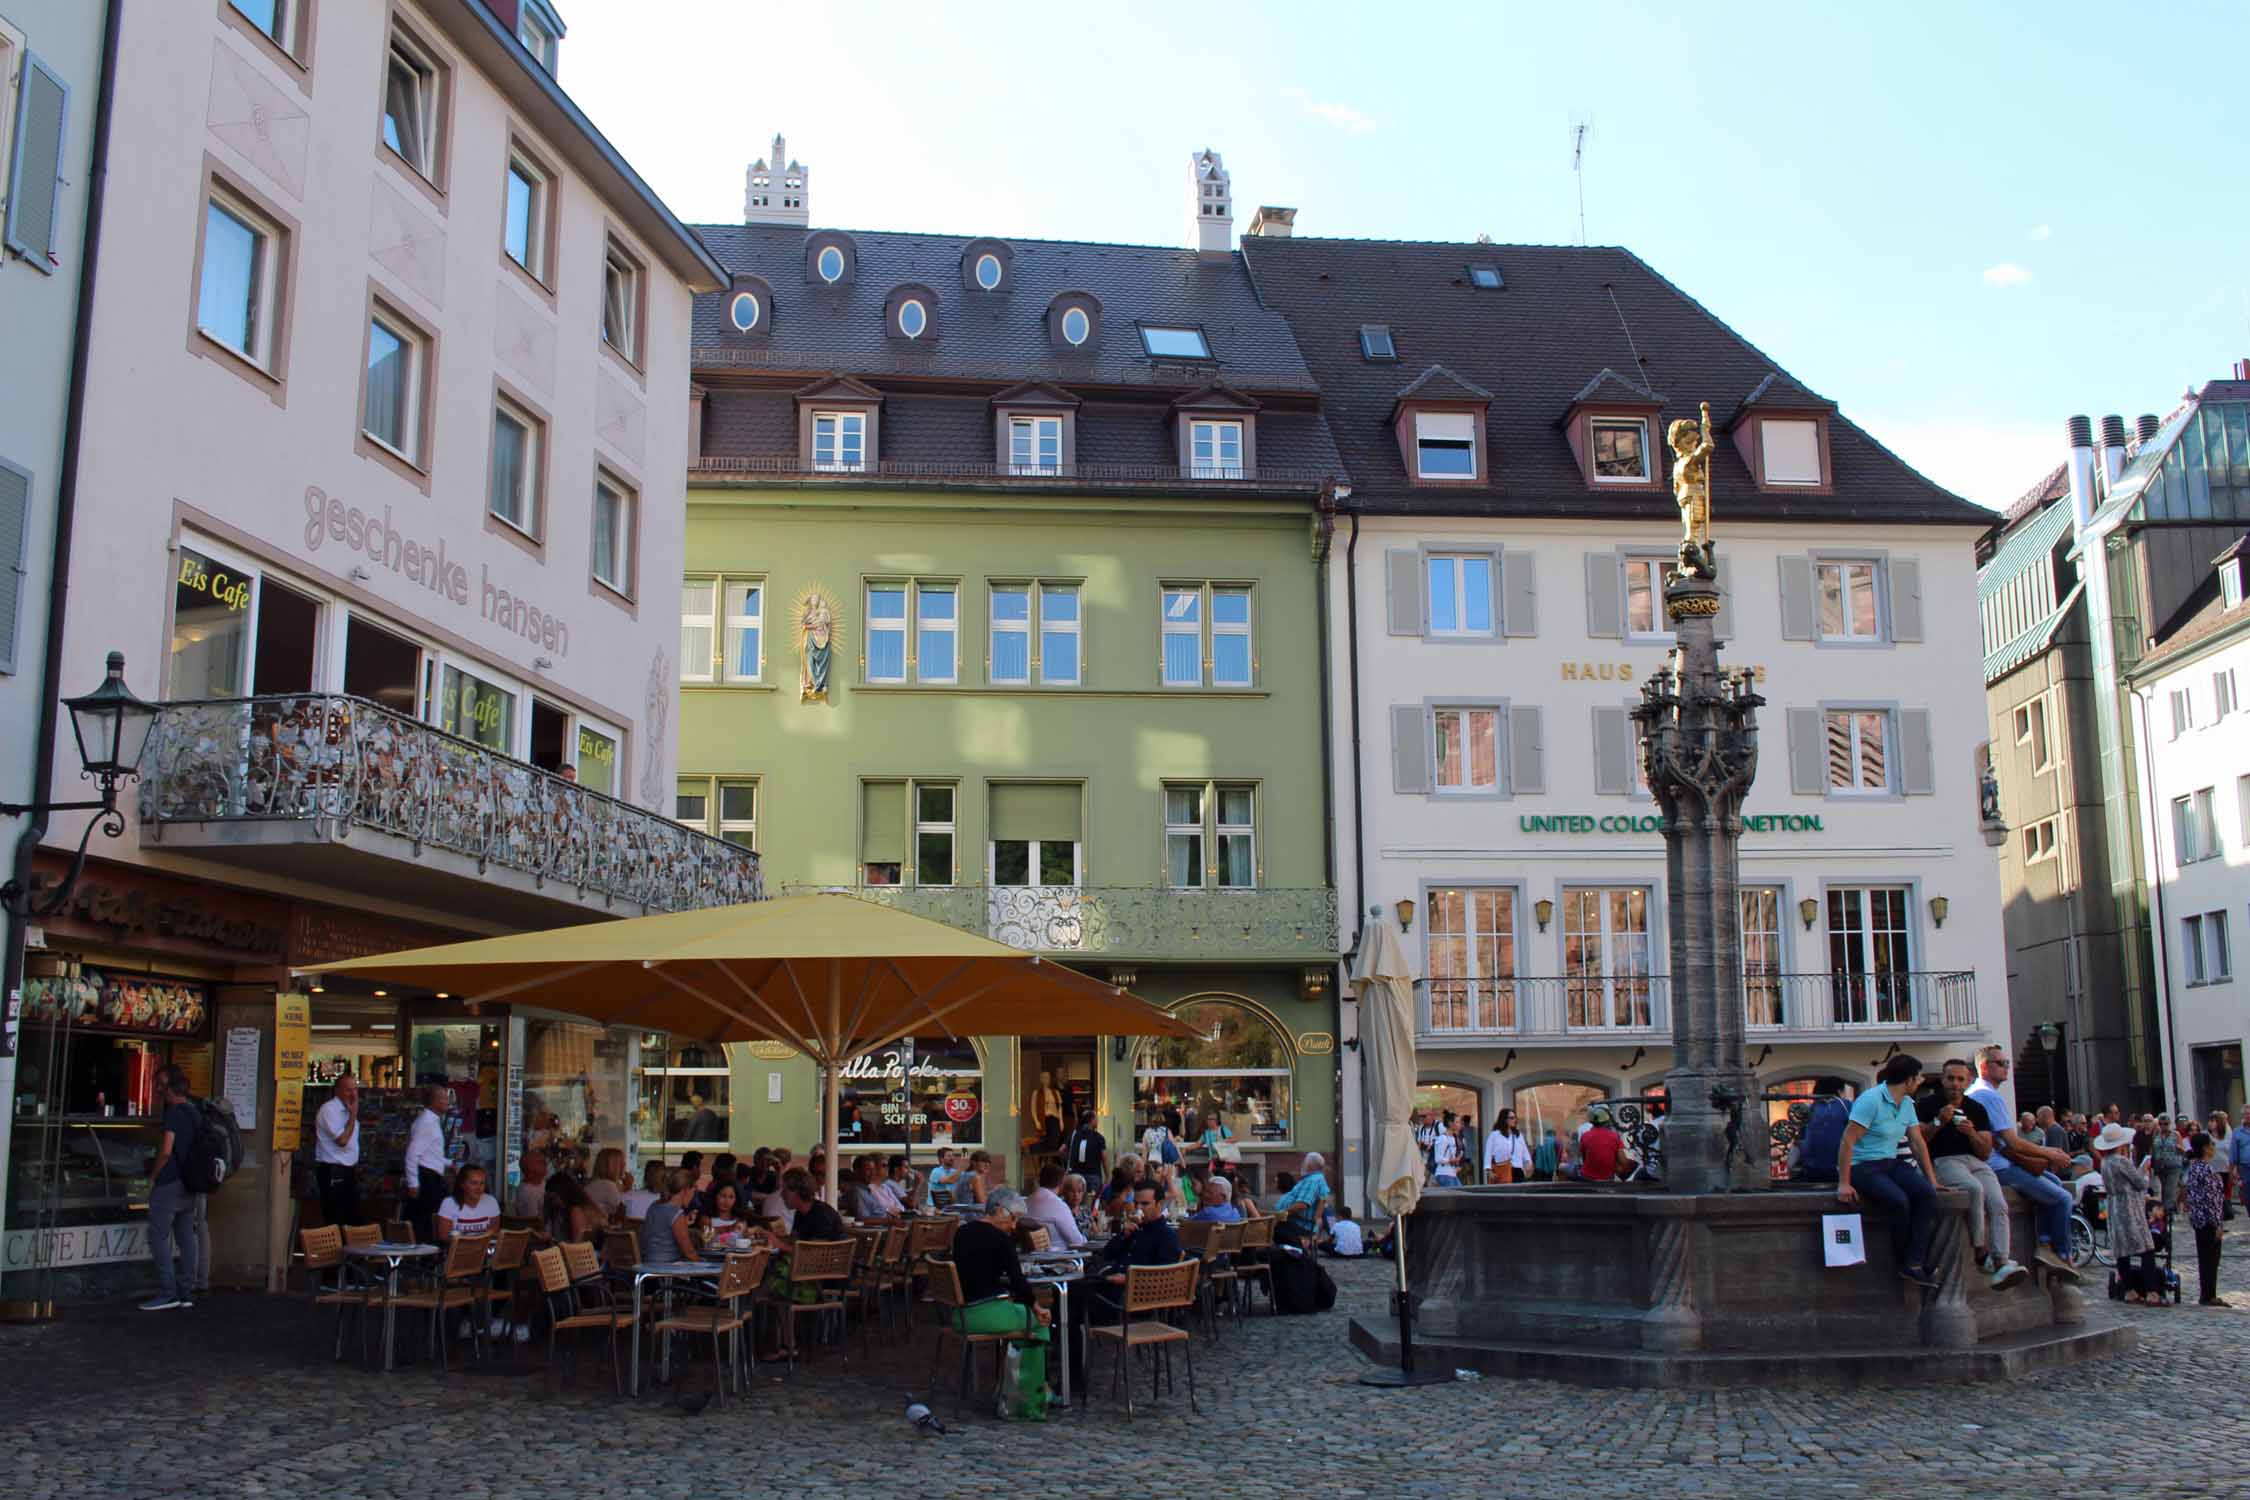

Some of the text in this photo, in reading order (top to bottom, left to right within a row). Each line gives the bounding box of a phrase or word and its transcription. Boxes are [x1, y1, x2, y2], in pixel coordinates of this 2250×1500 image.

[304, 484, 569, 657] geschenke hansen
[178, 558, 250, 612] Eis Cafe
[1561, 663, 1633, 681] HAUS
[461, 686, 499, 732] Cafe
[579, 732, 593, 755] Eis
[1519, 815, 1825, 833] UNITED COLO NETTON.
[881, 1103, 899, 1114] BIN
[950, 1098, 968, 1111] 30
